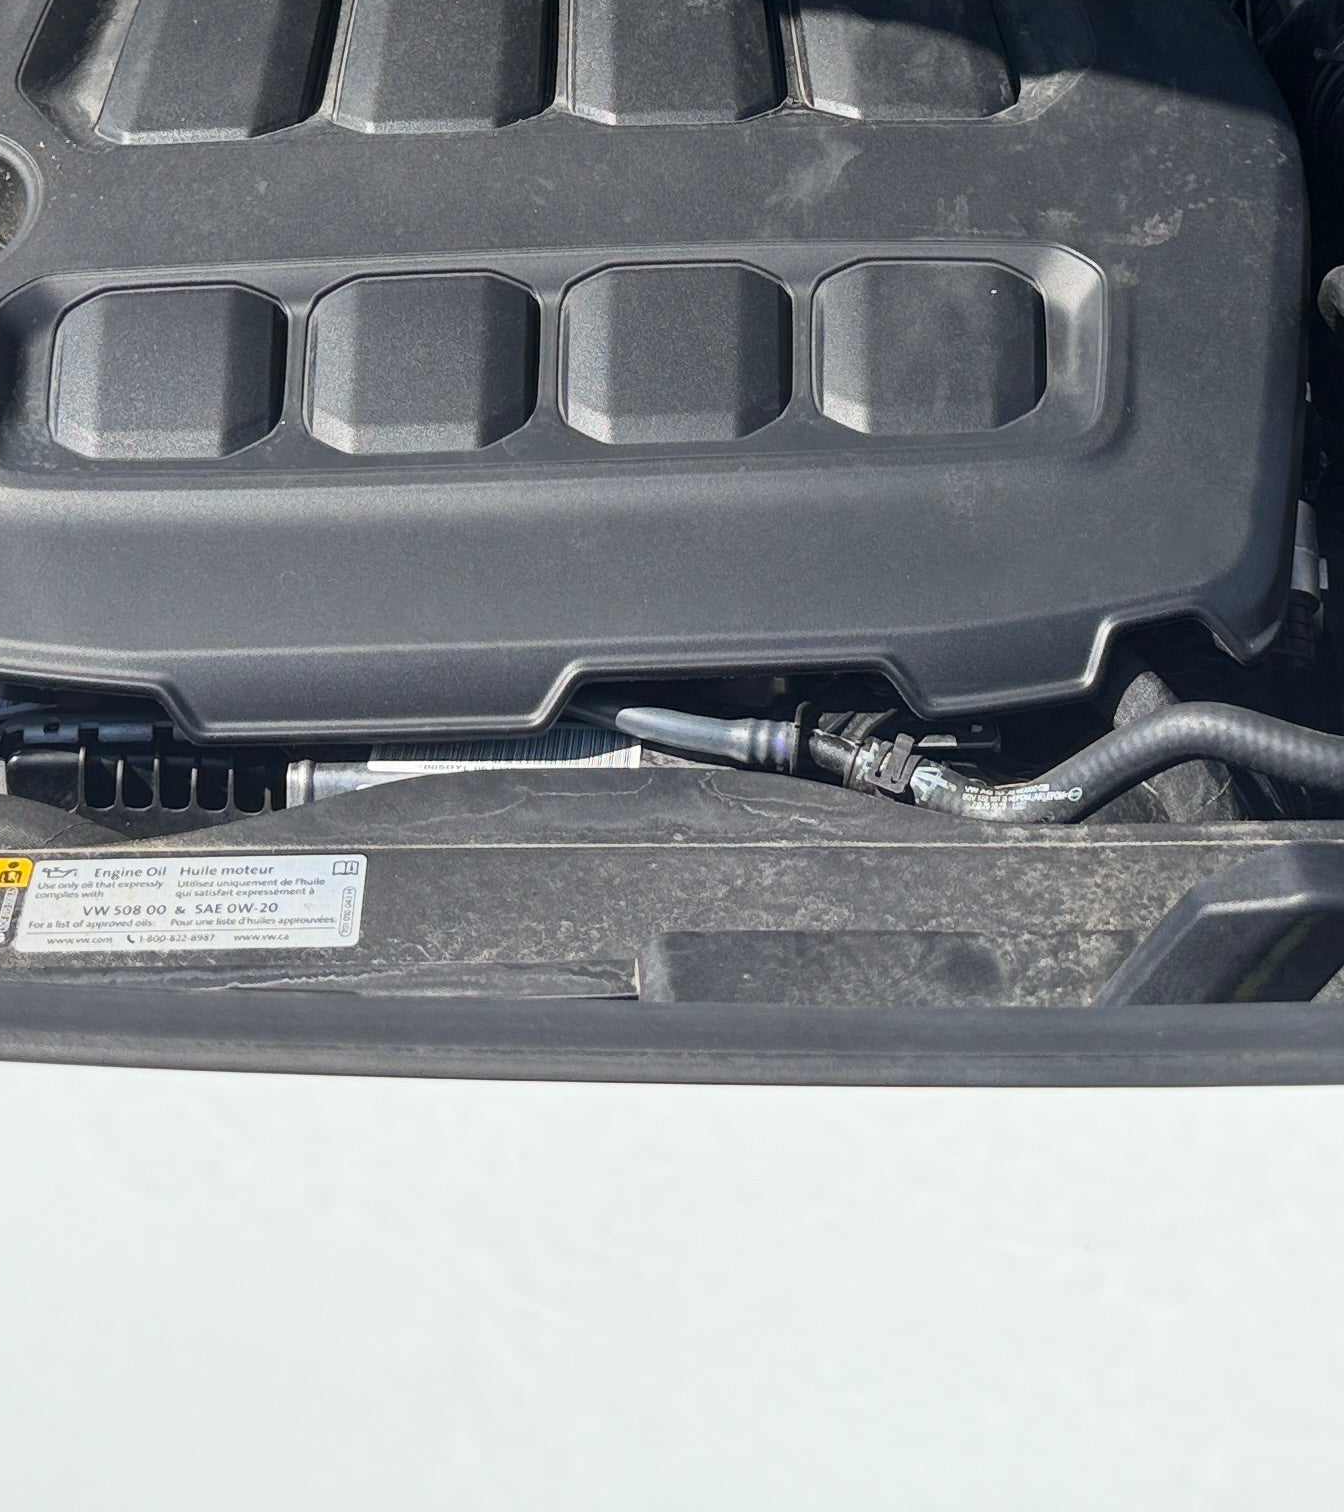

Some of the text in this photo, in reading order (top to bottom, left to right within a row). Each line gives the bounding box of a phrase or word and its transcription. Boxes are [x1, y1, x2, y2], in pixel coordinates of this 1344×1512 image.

[94, 866, 167, 880] Engine Oil
[180, 865, 275, 876] Huile moteur
[37, 879, 165, 891] Use only oil that expressly
[177, 879, 214, 888] Utilisez
[216, 878, 278, 889] uniquement
[280, 878, 293, 886] de
[35, 890, 104, 900] complies with
[175, 887, 315, 899] qui satisfait expressément à
[83, 902, 279, 916] VW 508 00 & SAE 0W-20
[28, 920, 45, 929] For
[55, 920, 71, 929] list
[72, 920, 84, 928] of
[85, 919, 133, 930] approved
[170, 918, 194, 927] Pour
[215, 917, 236, 926] liste
